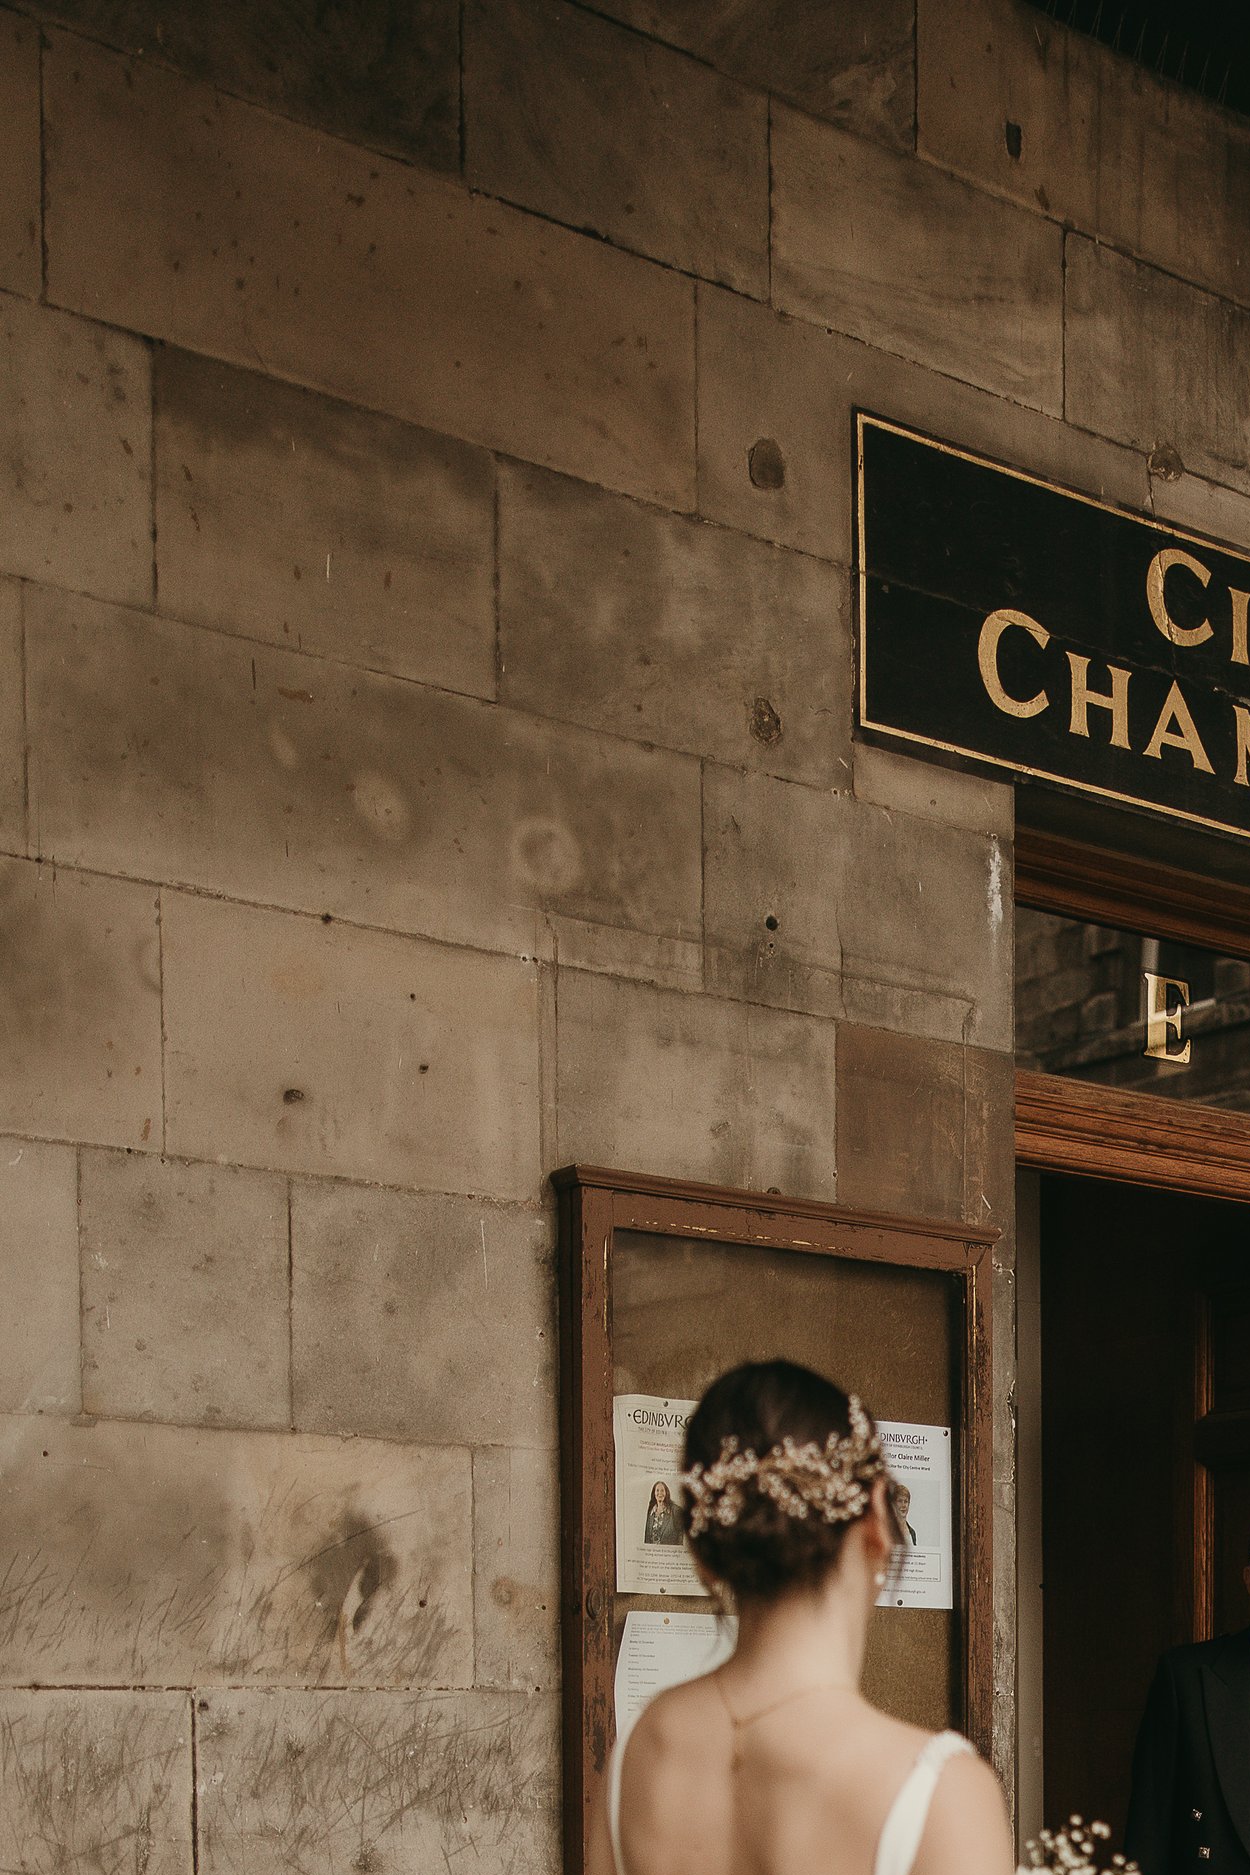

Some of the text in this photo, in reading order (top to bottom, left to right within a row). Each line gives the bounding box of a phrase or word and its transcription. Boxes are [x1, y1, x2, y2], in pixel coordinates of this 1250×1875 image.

[1143, 972, 1191, 1064] E
[632, 1409, 694, 1430] EDINBVR
[879, 1432, 925, 1445] DINBVRGH
